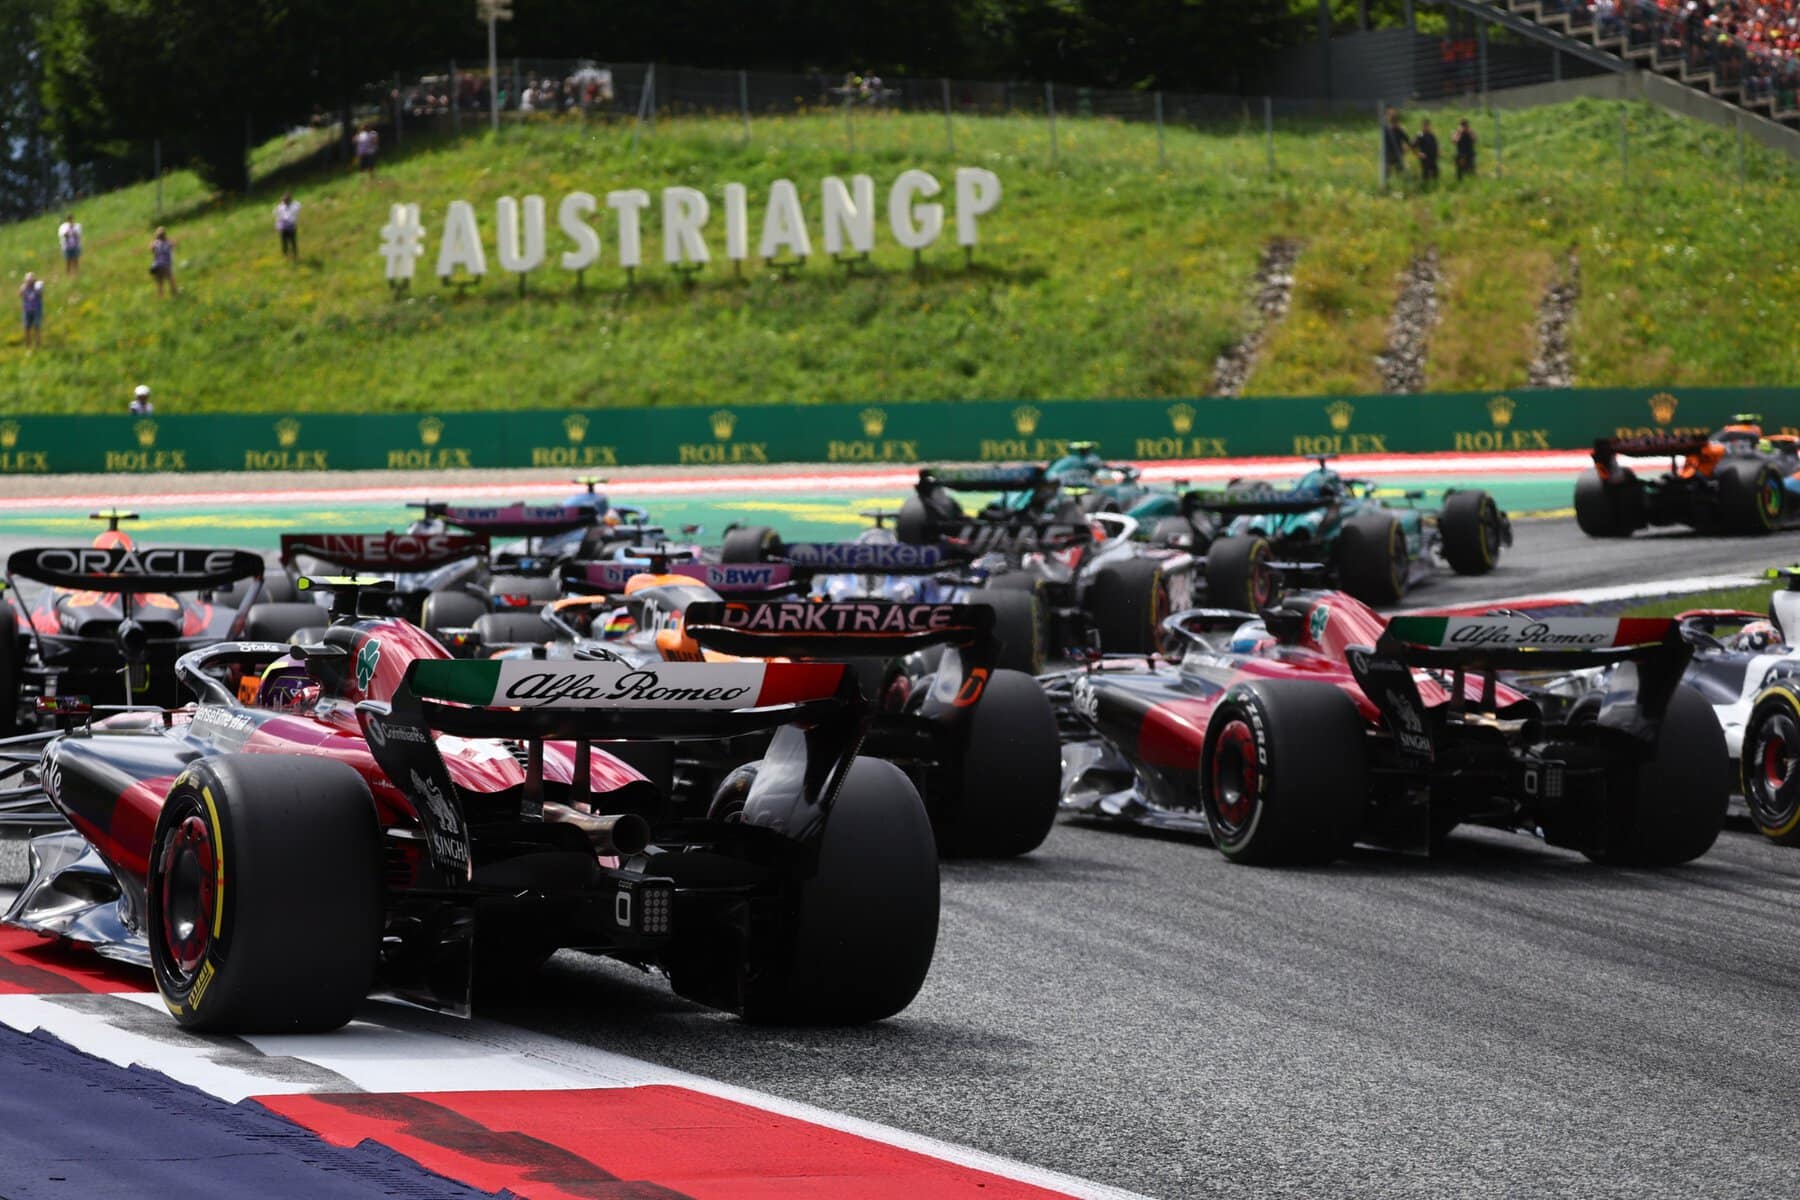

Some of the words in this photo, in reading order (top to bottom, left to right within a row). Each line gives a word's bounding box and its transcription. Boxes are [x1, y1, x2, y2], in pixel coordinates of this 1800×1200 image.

[380, 167, 1001, 280] #AUSTRIANGP
[828, 440, 918, 461] ROLEX
[980, 438, 1069, 460] ROLEX
[1136, 437, 1228, 458] ROLEX
[1293, 434, 1387, 454] ROLEX
[1454, 429, 1549, 451] ROLEX
[0, 449, 49, 472] LEX
[105, 449, 187, 471] ROLEX
[245, 448, 328, 471] ROLEX
[387, 448, 472, 470] ROLEX
[532, 446, 618, 468] ROLEX
[679, 442, 767, 464] ROLEX
[321, 535, 450, 561] INEOS
[820, 542, 940, 567] kraken
[36, 550, 236, 576] ORACLE
[726, 569, 773, 584] BWT
[723, 603, 954, 631] DARKTRACE
[1450, 623, 1512, 647] Alfa
[1515, 622, 1607, 644] Romeo
[505, 673, 605, 707] Alfa
[605, 671, 750, 701] Romeo
[1246, 703, 1268, 765] ZERO
[434, 832, 469, 861] SINGHA
